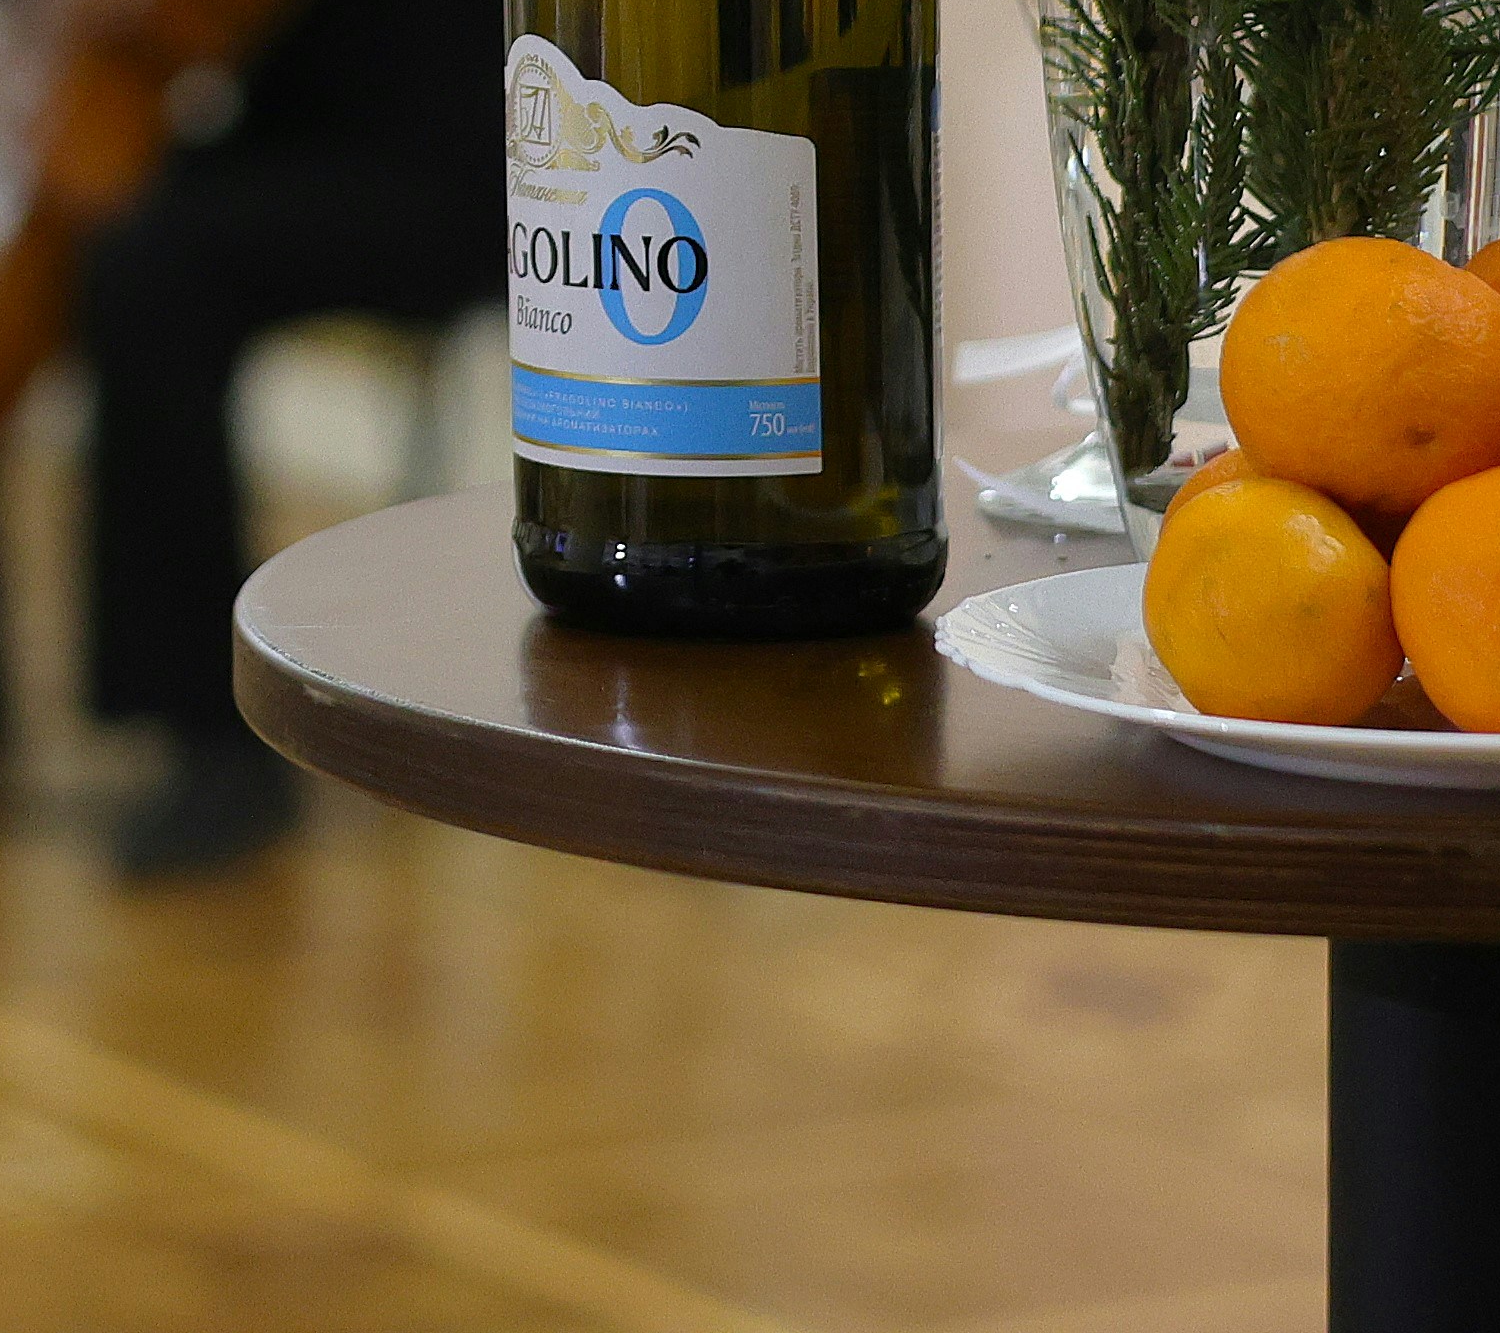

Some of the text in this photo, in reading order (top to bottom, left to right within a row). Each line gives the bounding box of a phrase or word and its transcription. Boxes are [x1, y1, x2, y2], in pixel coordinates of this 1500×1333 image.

[507, 215, 709, 294] GOLINO
[517, 294, 573, 334] Bianco
[749, 413, 785, 436] 750
